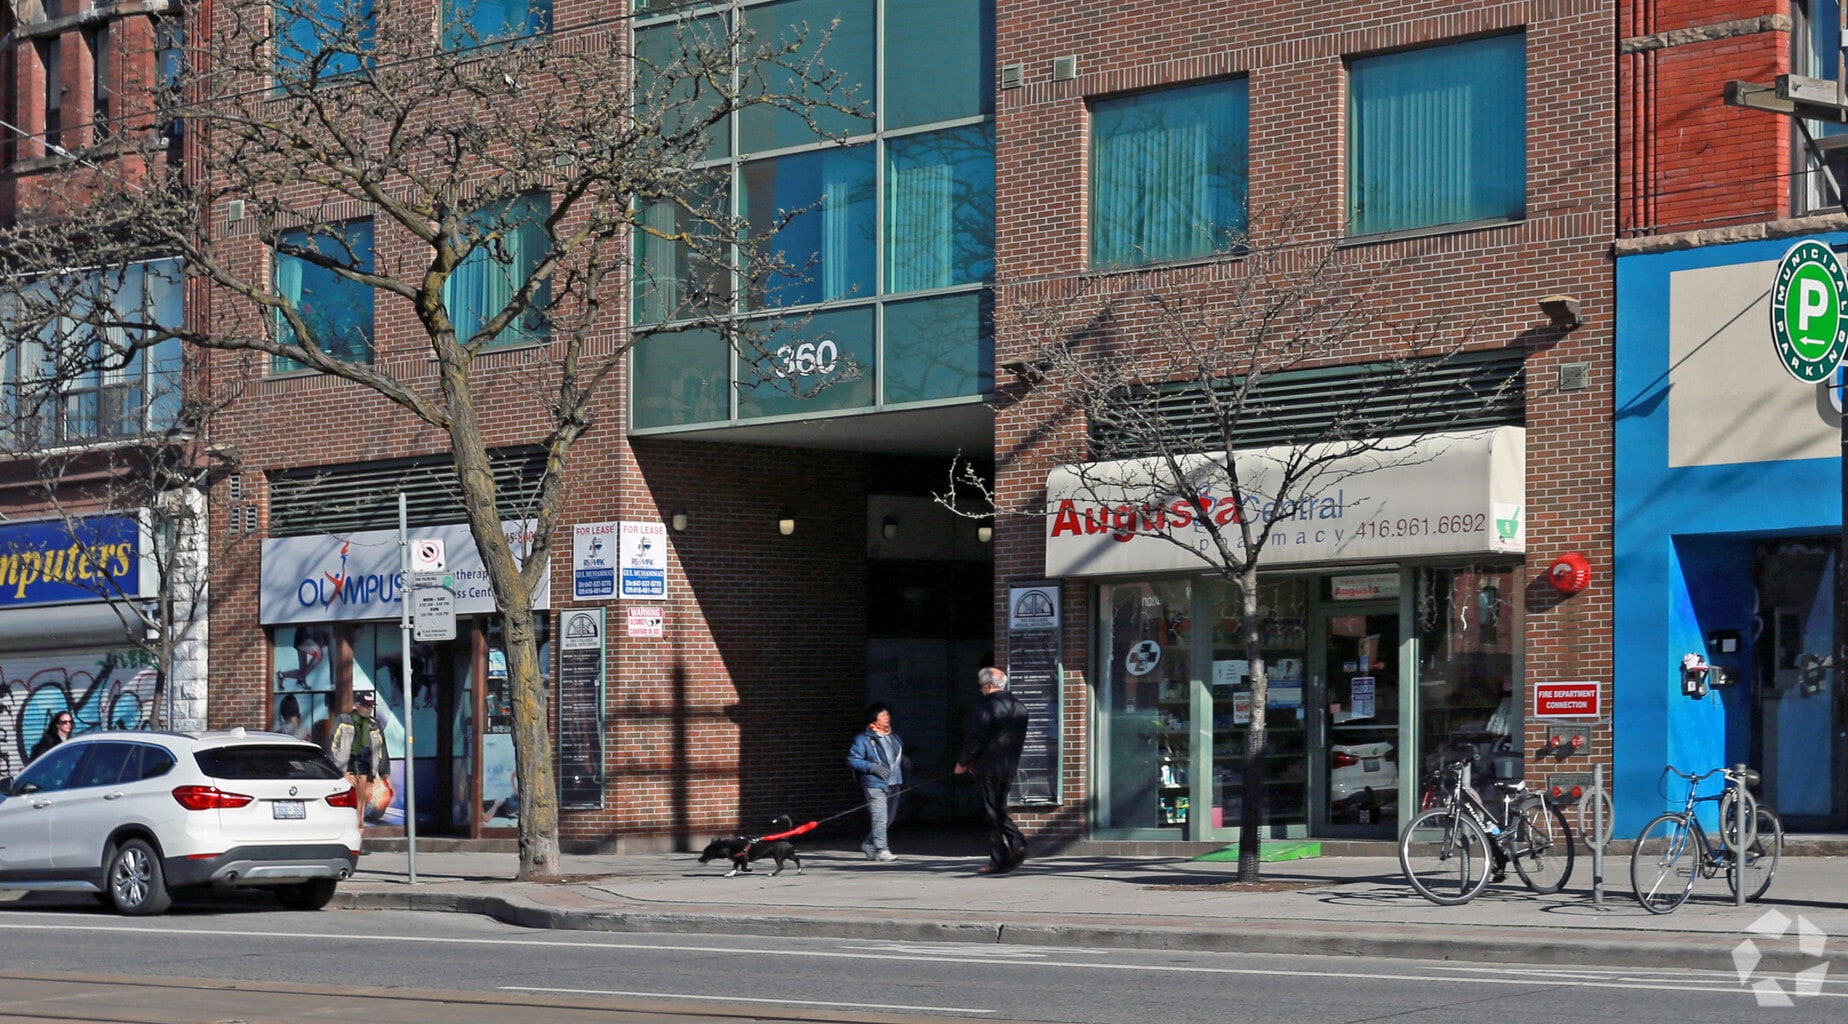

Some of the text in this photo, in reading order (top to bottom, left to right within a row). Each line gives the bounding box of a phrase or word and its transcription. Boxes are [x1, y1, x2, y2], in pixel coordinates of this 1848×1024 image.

[1777, 248, 1848, 311] MUNICIPAL
[1799, 278, 1829, 331] P
[775, 339, 838, 378] 360
[1777, 319, 1847, 376] PARKING
[1051, 491, 1242, 543] Augusta
[1242, 489, 1344, 525] Central
[576, 525, 615, 536] FOR LEASE
[623, 525, 664, 535] FOR LEASE
[1355, 513, 1487, 539] 416.961.6692
[1538, 689, 1596, 699] FIRE DEPARTMENT
[1545, 700, 1588, 709] CONNECTION
